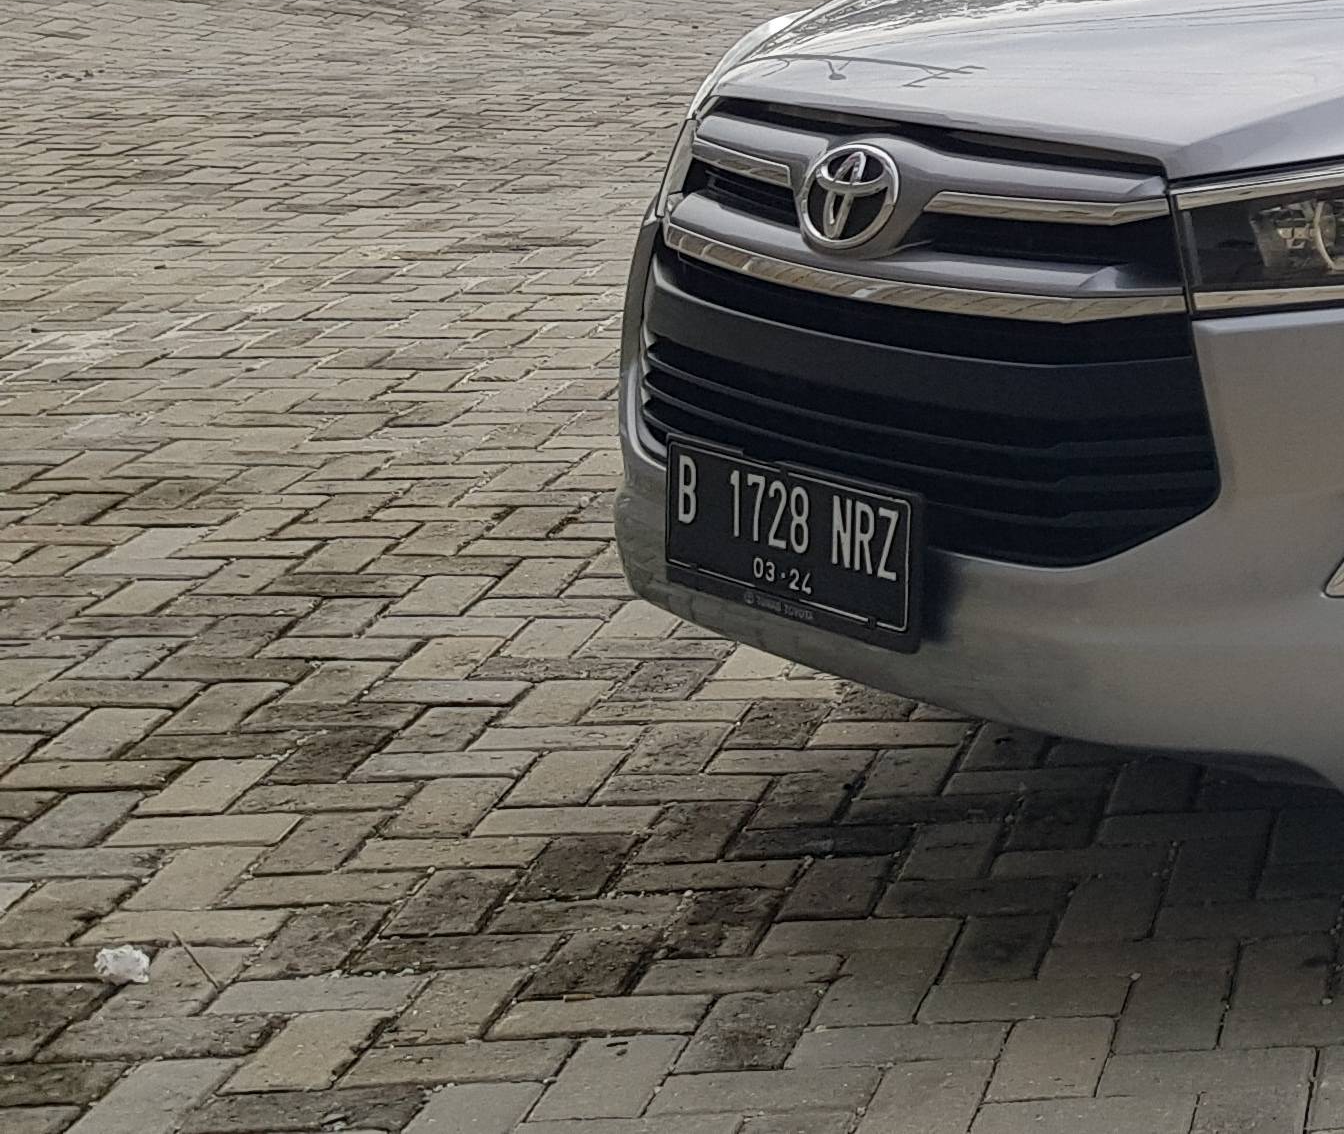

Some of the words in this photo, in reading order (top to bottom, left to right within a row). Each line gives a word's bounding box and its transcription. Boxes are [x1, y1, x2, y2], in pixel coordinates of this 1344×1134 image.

[677, 455, 697, 524] B
[729, 469, 809, 554] 1728
[831, 494, 899, 581] NRZ
